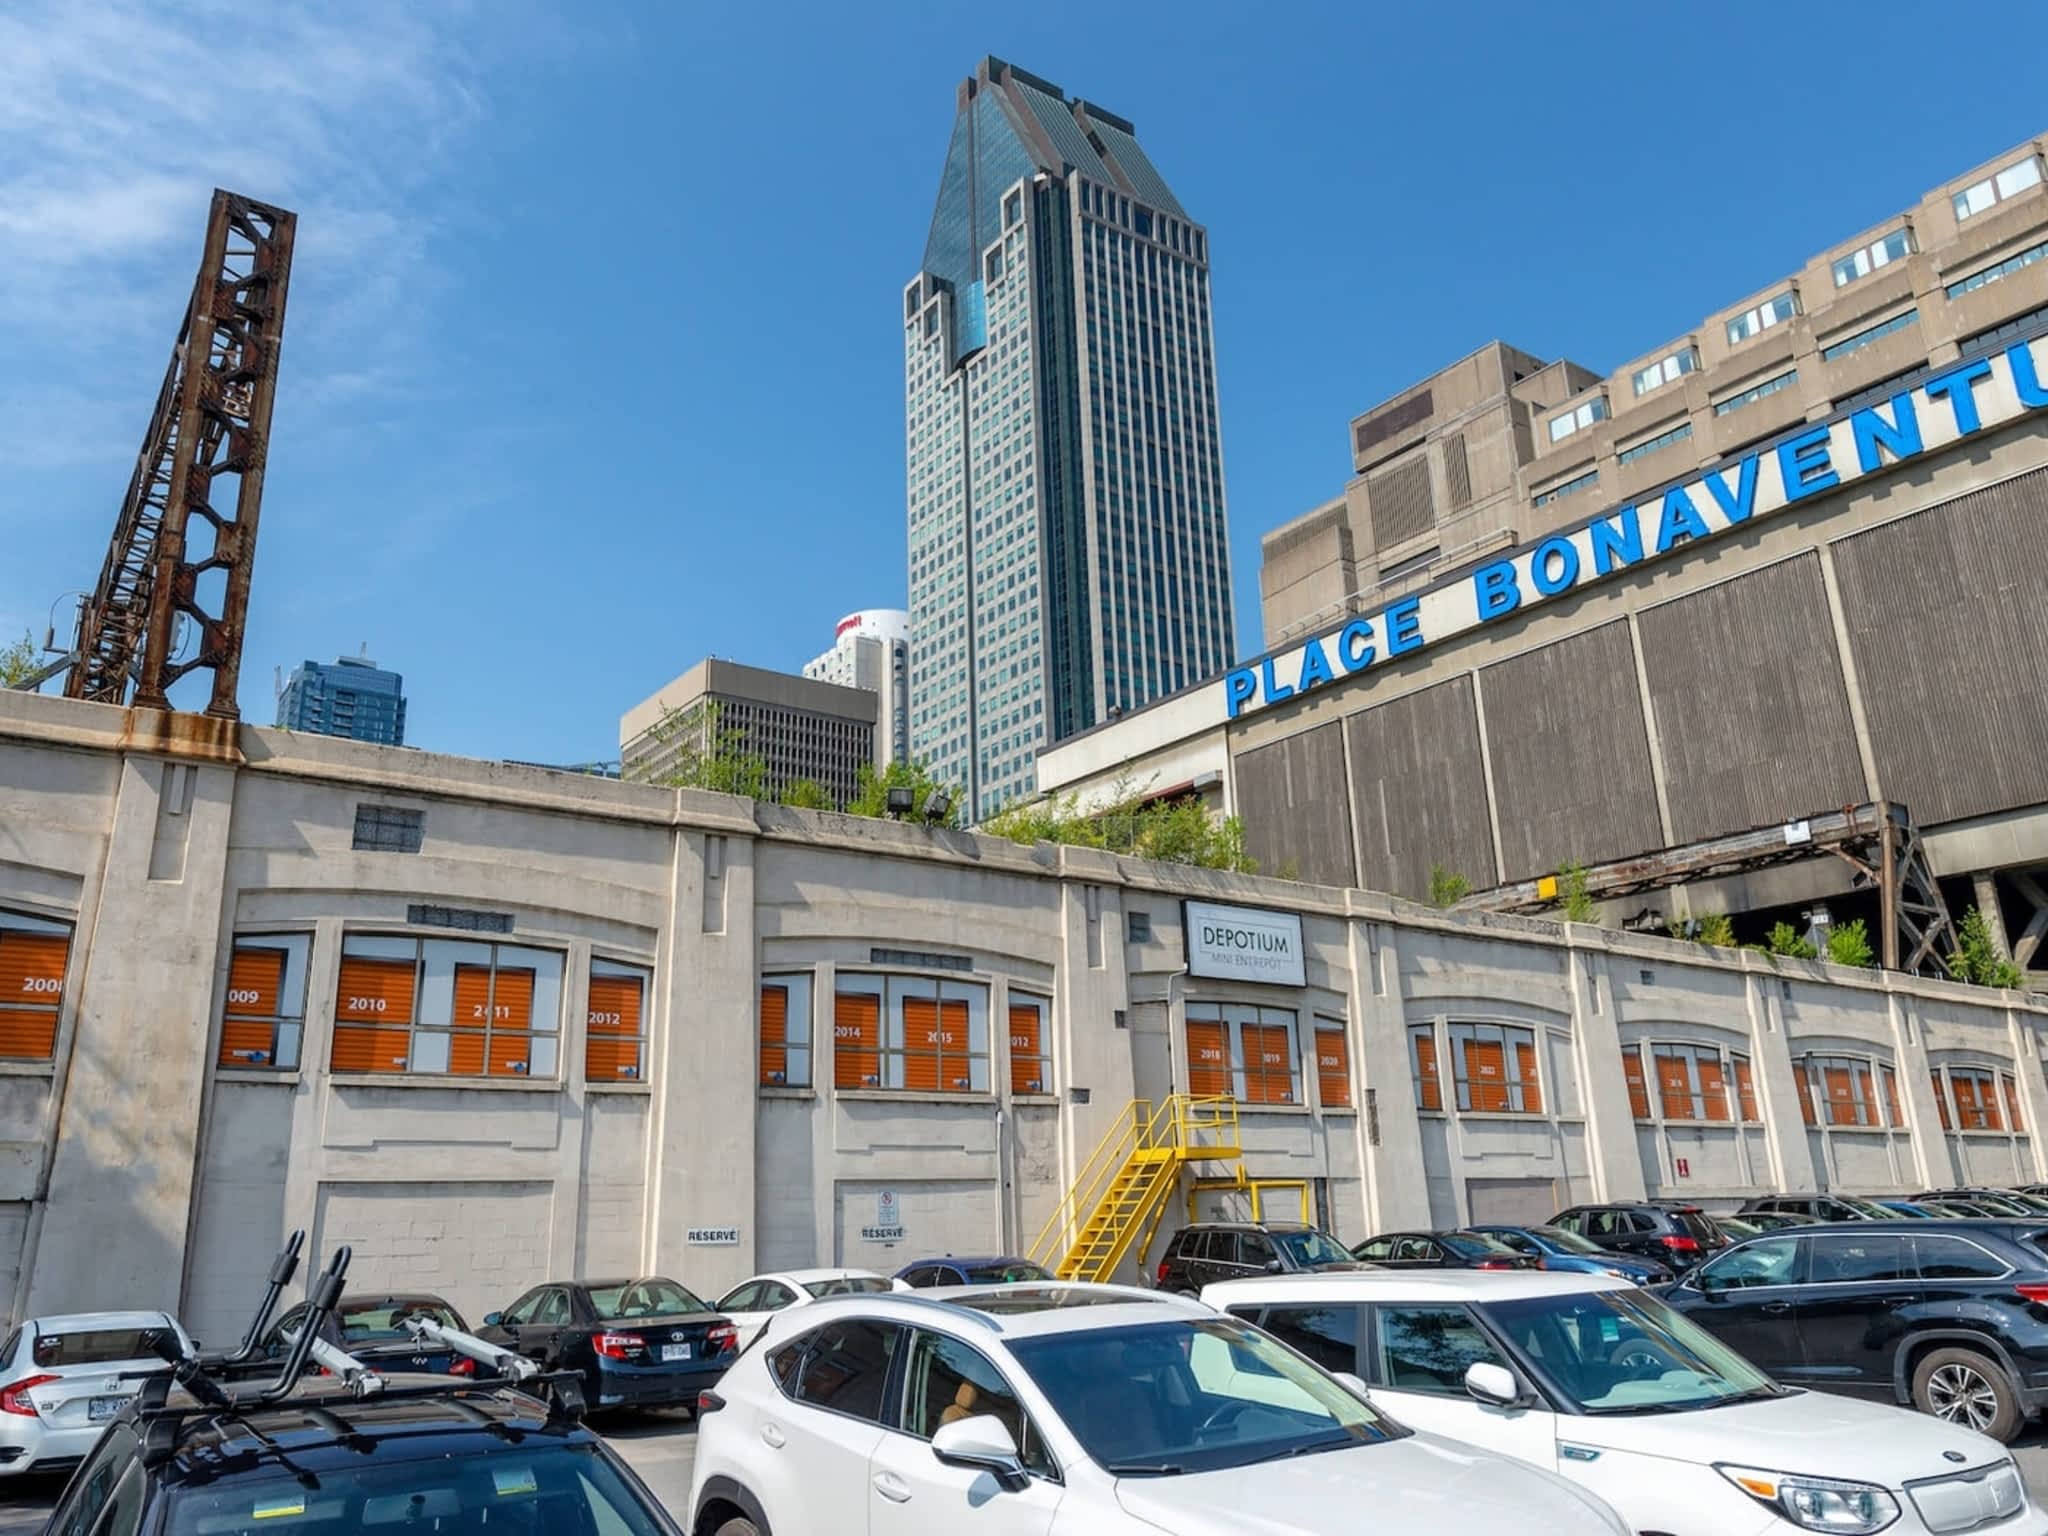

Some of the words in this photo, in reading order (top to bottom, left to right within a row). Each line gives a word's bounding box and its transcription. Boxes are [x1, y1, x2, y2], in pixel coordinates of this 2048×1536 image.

[1224, 596, 1424, 719] PLACE
[1473, 339, 2048, 622] BONAVENTU
[1203, 926, 1288, 953] DEPOTIUM
[22, 977, 62, 992] 200
[228, 990, 259, 1003] 009
[348, 997, 386, 1012] 2010
[473, 1004, 510, 1018] 211
[588, 1011, 621, 1024] 2012
[834, 1026, 861, 1039] 2014
